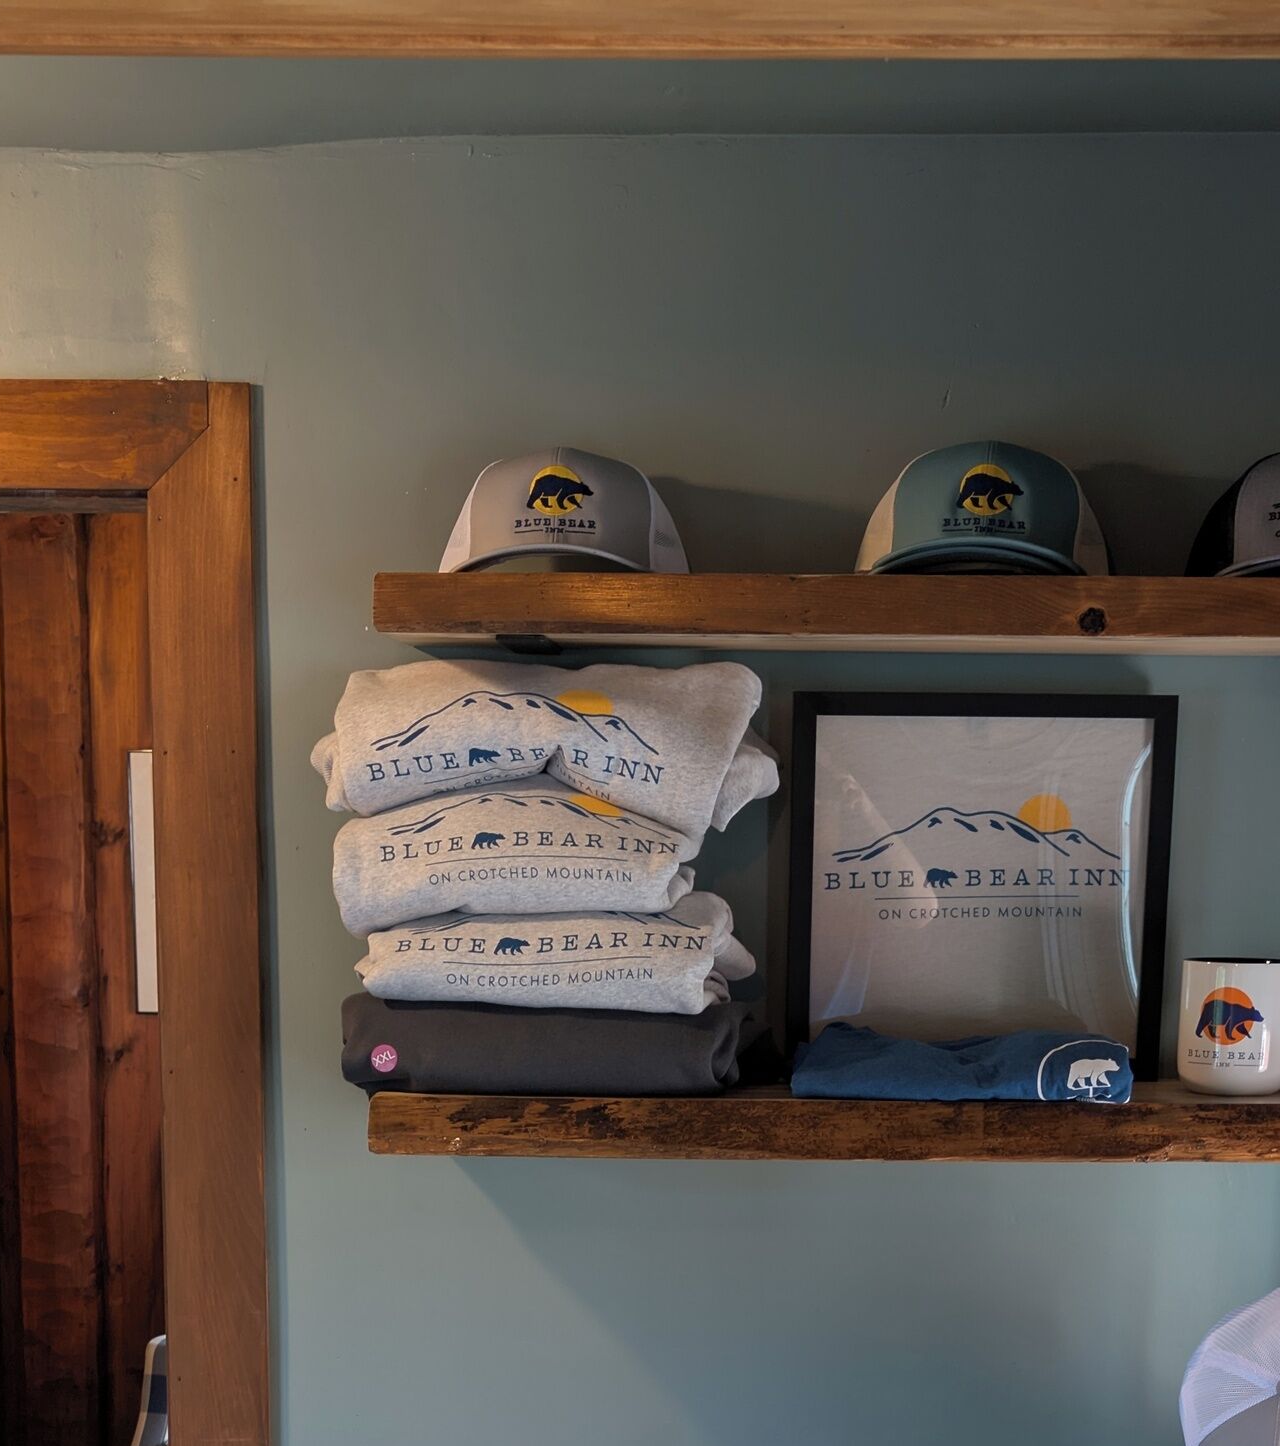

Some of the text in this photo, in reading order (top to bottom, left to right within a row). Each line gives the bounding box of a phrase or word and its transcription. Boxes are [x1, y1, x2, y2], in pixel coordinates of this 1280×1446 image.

[514, 518, 596, 529] BLUE BEAR
[943, 517, 1026, 529] BLUE BEAR
[366, 747, 665, 785] BLUE BER INN
[380, 831, 680, 862] BLUE BEAR INN
[428, 866, 632, 885] ON CROTCHED MOUNTAIN
[824, 868, 1130, 890] BLUE BEAR INN
[878, 906, 1082, 920] ON CROTCHED MOUNTAIN
[395, 932, 707, 954] BLUE BEAR INN
[446, 968, 654, 987] ON CROTCHED MOUNTAIN
[372, 1050, 396, 1067] XXL
[1187, 1049, 1219, 1059] BLUE
